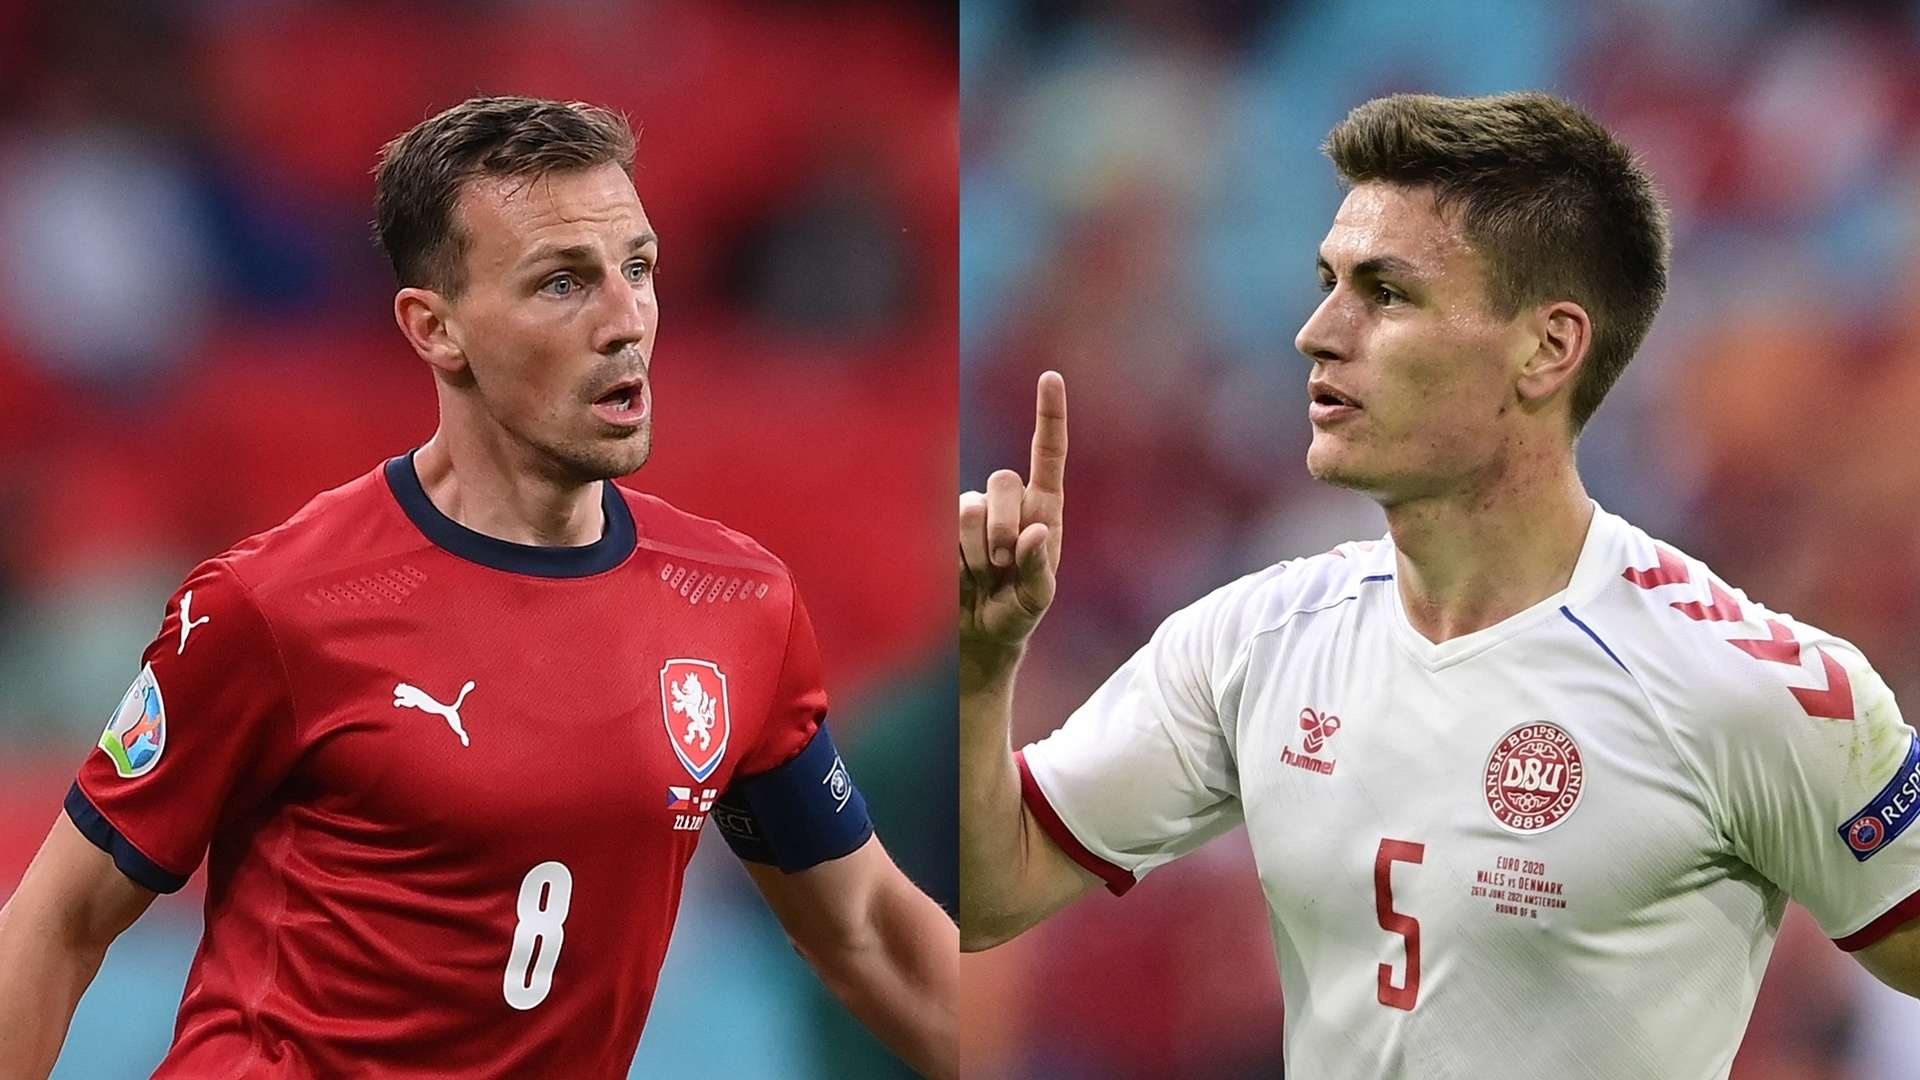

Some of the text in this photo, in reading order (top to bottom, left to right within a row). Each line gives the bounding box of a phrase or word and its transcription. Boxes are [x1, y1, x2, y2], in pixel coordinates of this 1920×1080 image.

[1280, 745, 1336, 775] hummel
[1502, 757, 1565, 793] DBU
[1487, 748, 1507, 812] DANSK
[1550, 761, 1582, 819] UNION
[1503, 811, 1546, 829] 1889
[1496, 855, 1545, 876] EURO 2020
[1476, 870, 1505, 886] WALES
[1518, 876, 1563, 896] DENMARK
[1488, 888, 1505, 900] JUNE
[1507, 891, 1523, 903] 2021
[1524, 894, 1567, 909] AMSTERDAM
[1496, 903, 1518, 916] ROUND
[1520, 907, 1528, 917] OF
[503, 861, 573, 1010] 8
[1374, 838, 1425, 1011] 5
